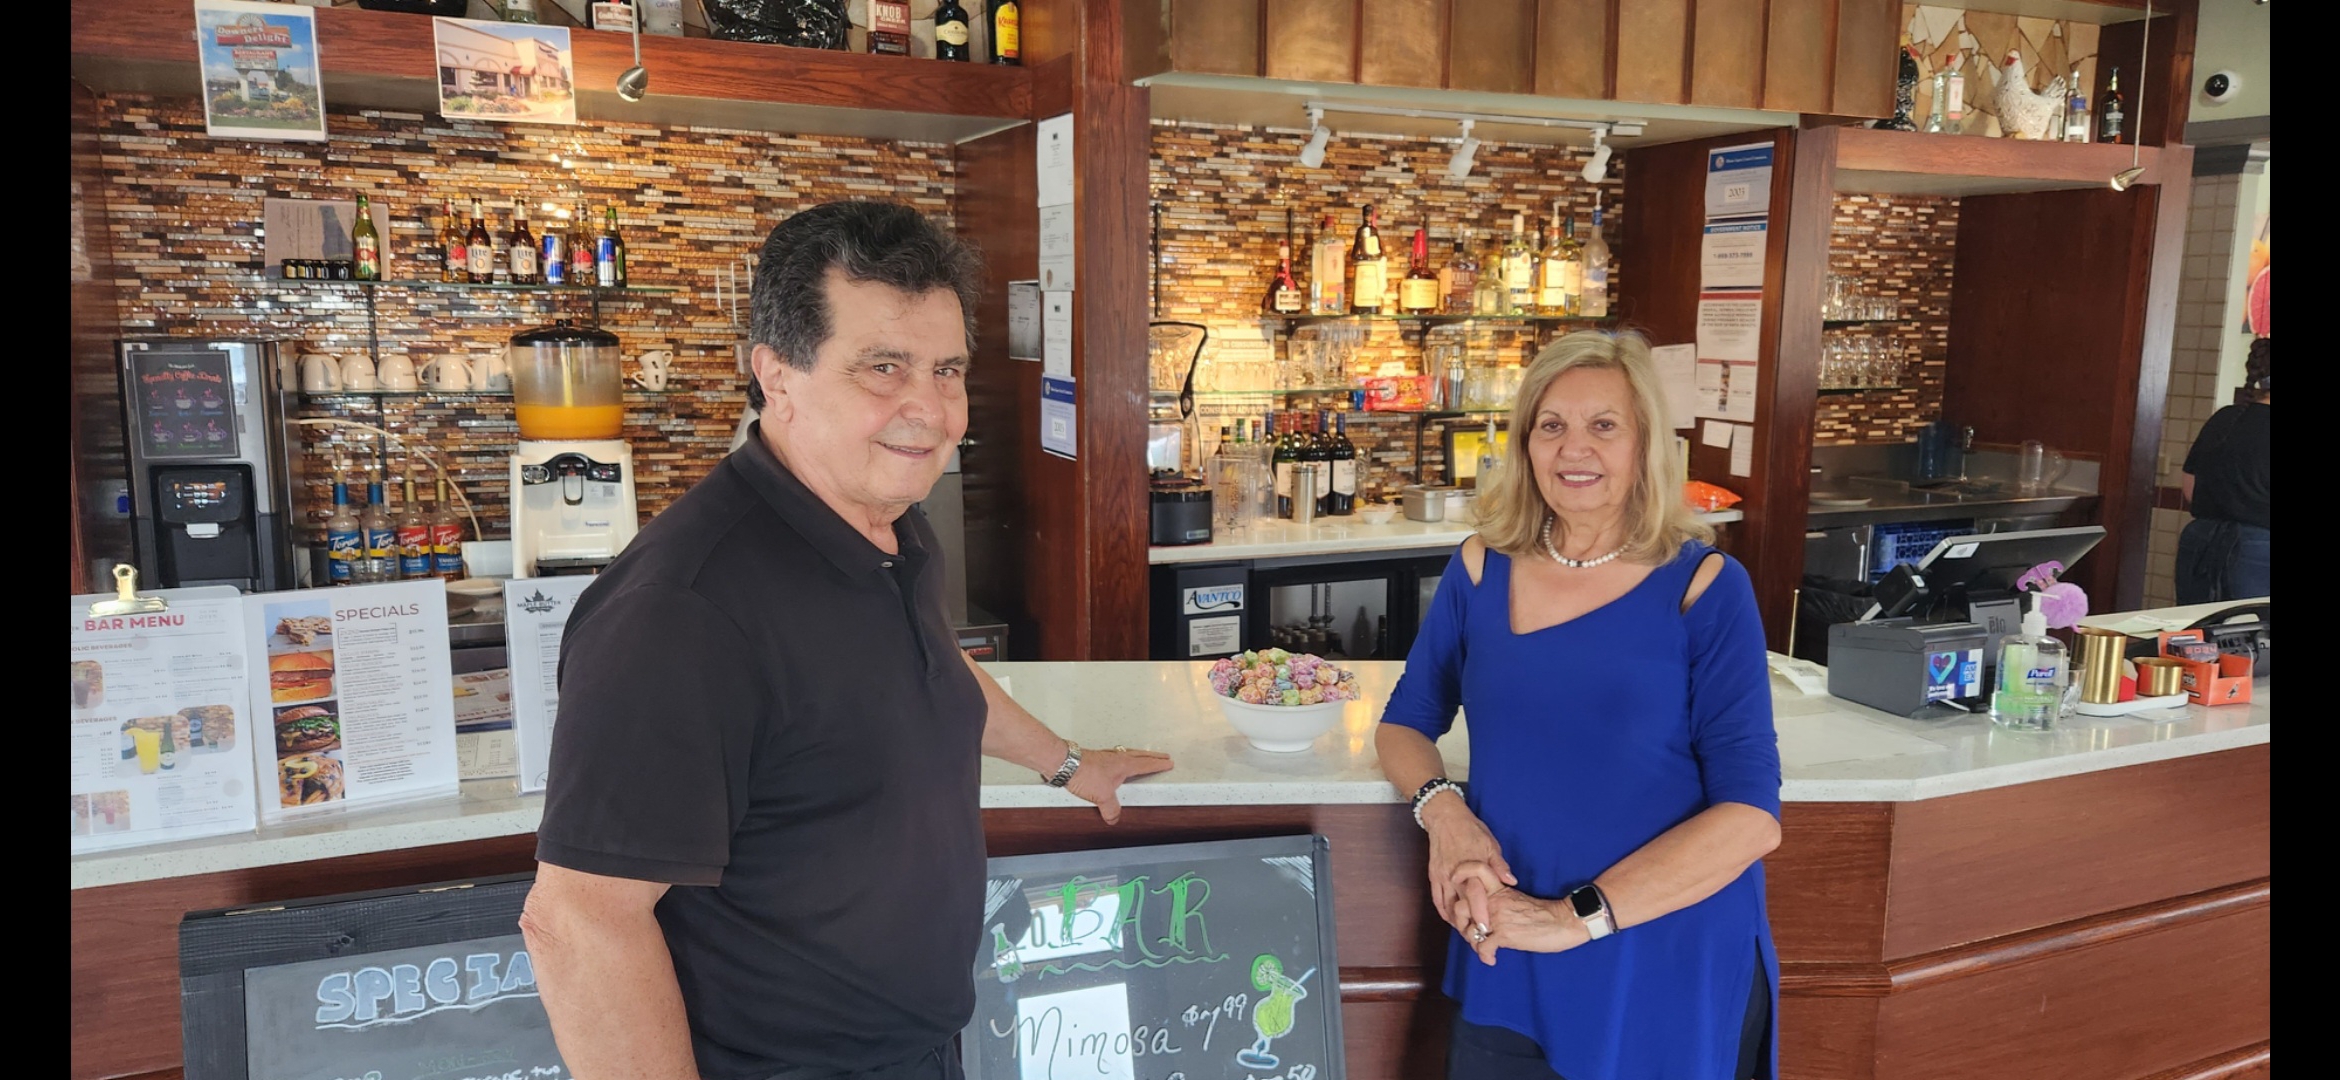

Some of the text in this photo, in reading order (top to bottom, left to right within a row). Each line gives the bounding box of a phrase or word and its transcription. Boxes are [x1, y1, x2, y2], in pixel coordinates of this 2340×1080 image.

[876, 3, 901, 19] KNOB
[217, 26, 264, 36] Downers
[243, 32, 288, 44] Delight
[471, 248, 488, 259] Lite
[517, 249, 533, 260] Lite
[398, 531, 427, 544] Torani
[1186, 590, 1242, 609] AVANTCO
[335, 603, 419, 622] SPECIALS
[84, 617, 124, 632] BAR
[129, 614, 185, 629] MENU
[1046, 871, 1212, 959] BAR
[315, 950, 536, 1023] SPECIA
[990, 1005, 1182, 1080] Mimosa
